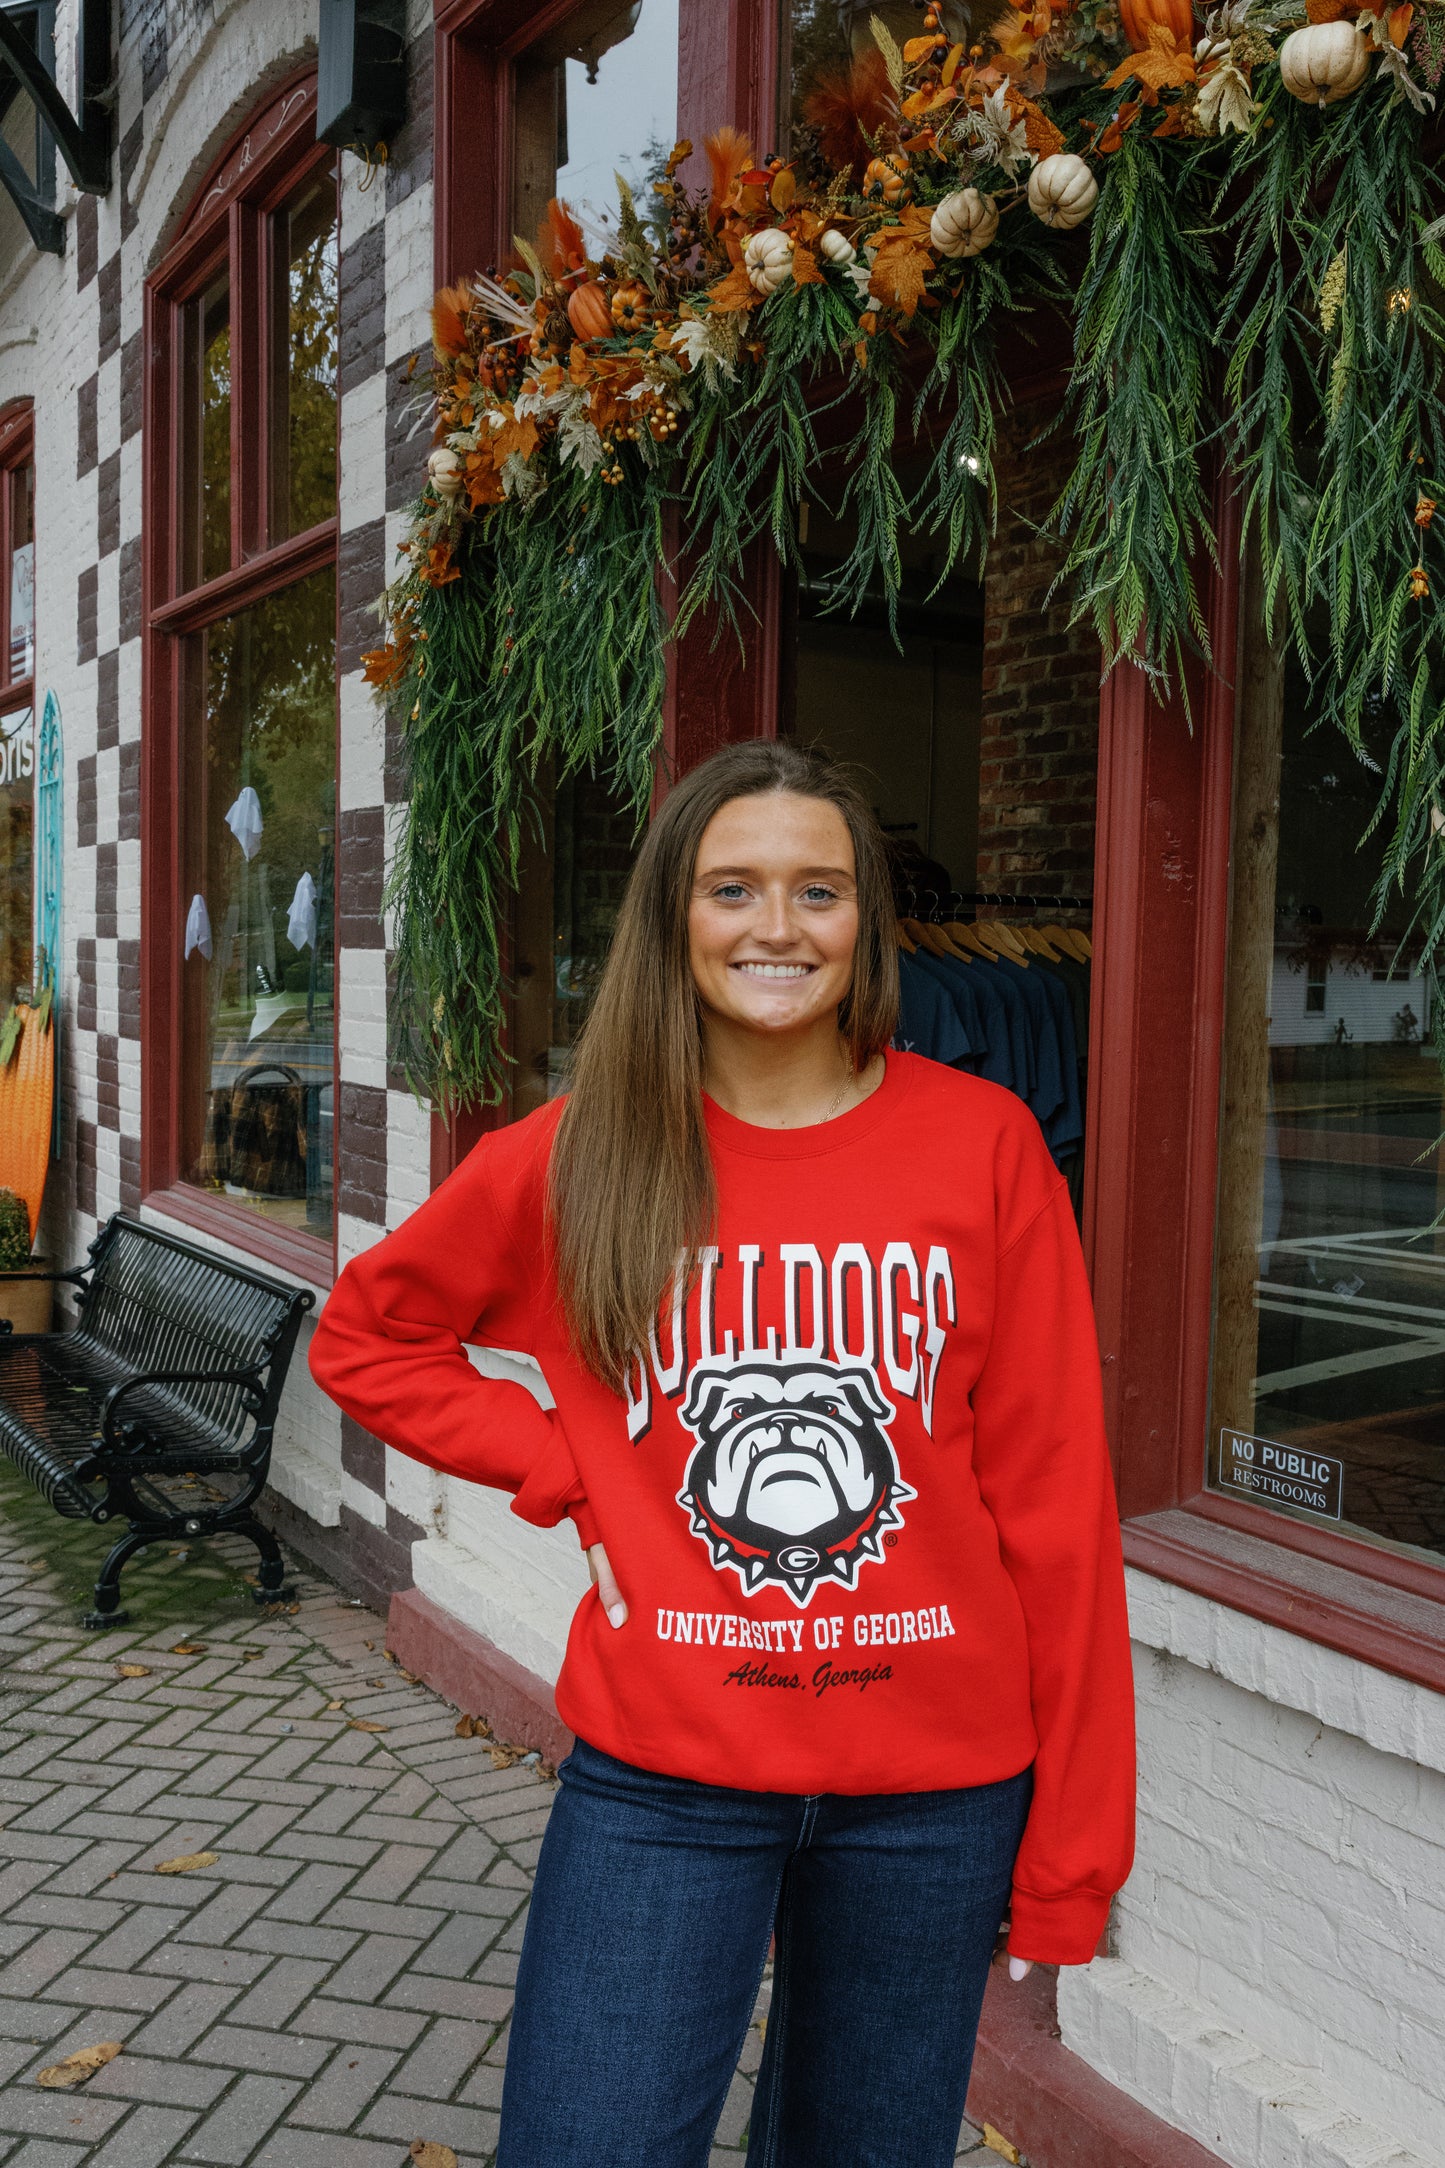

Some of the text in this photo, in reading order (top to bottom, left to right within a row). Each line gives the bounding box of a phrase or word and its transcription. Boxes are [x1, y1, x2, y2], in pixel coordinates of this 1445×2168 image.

[1232, 1438, 1330, 1483] NO PUBLIC
[1233, 1467, 1326, 1508] RESTROOMS
[788, 1551, 818, 1568] G
[657, 1605, 956, 1652] UNIVERSITY OF GEORGIA
[723, 1660, 894, 1697] Athens, Georgia
